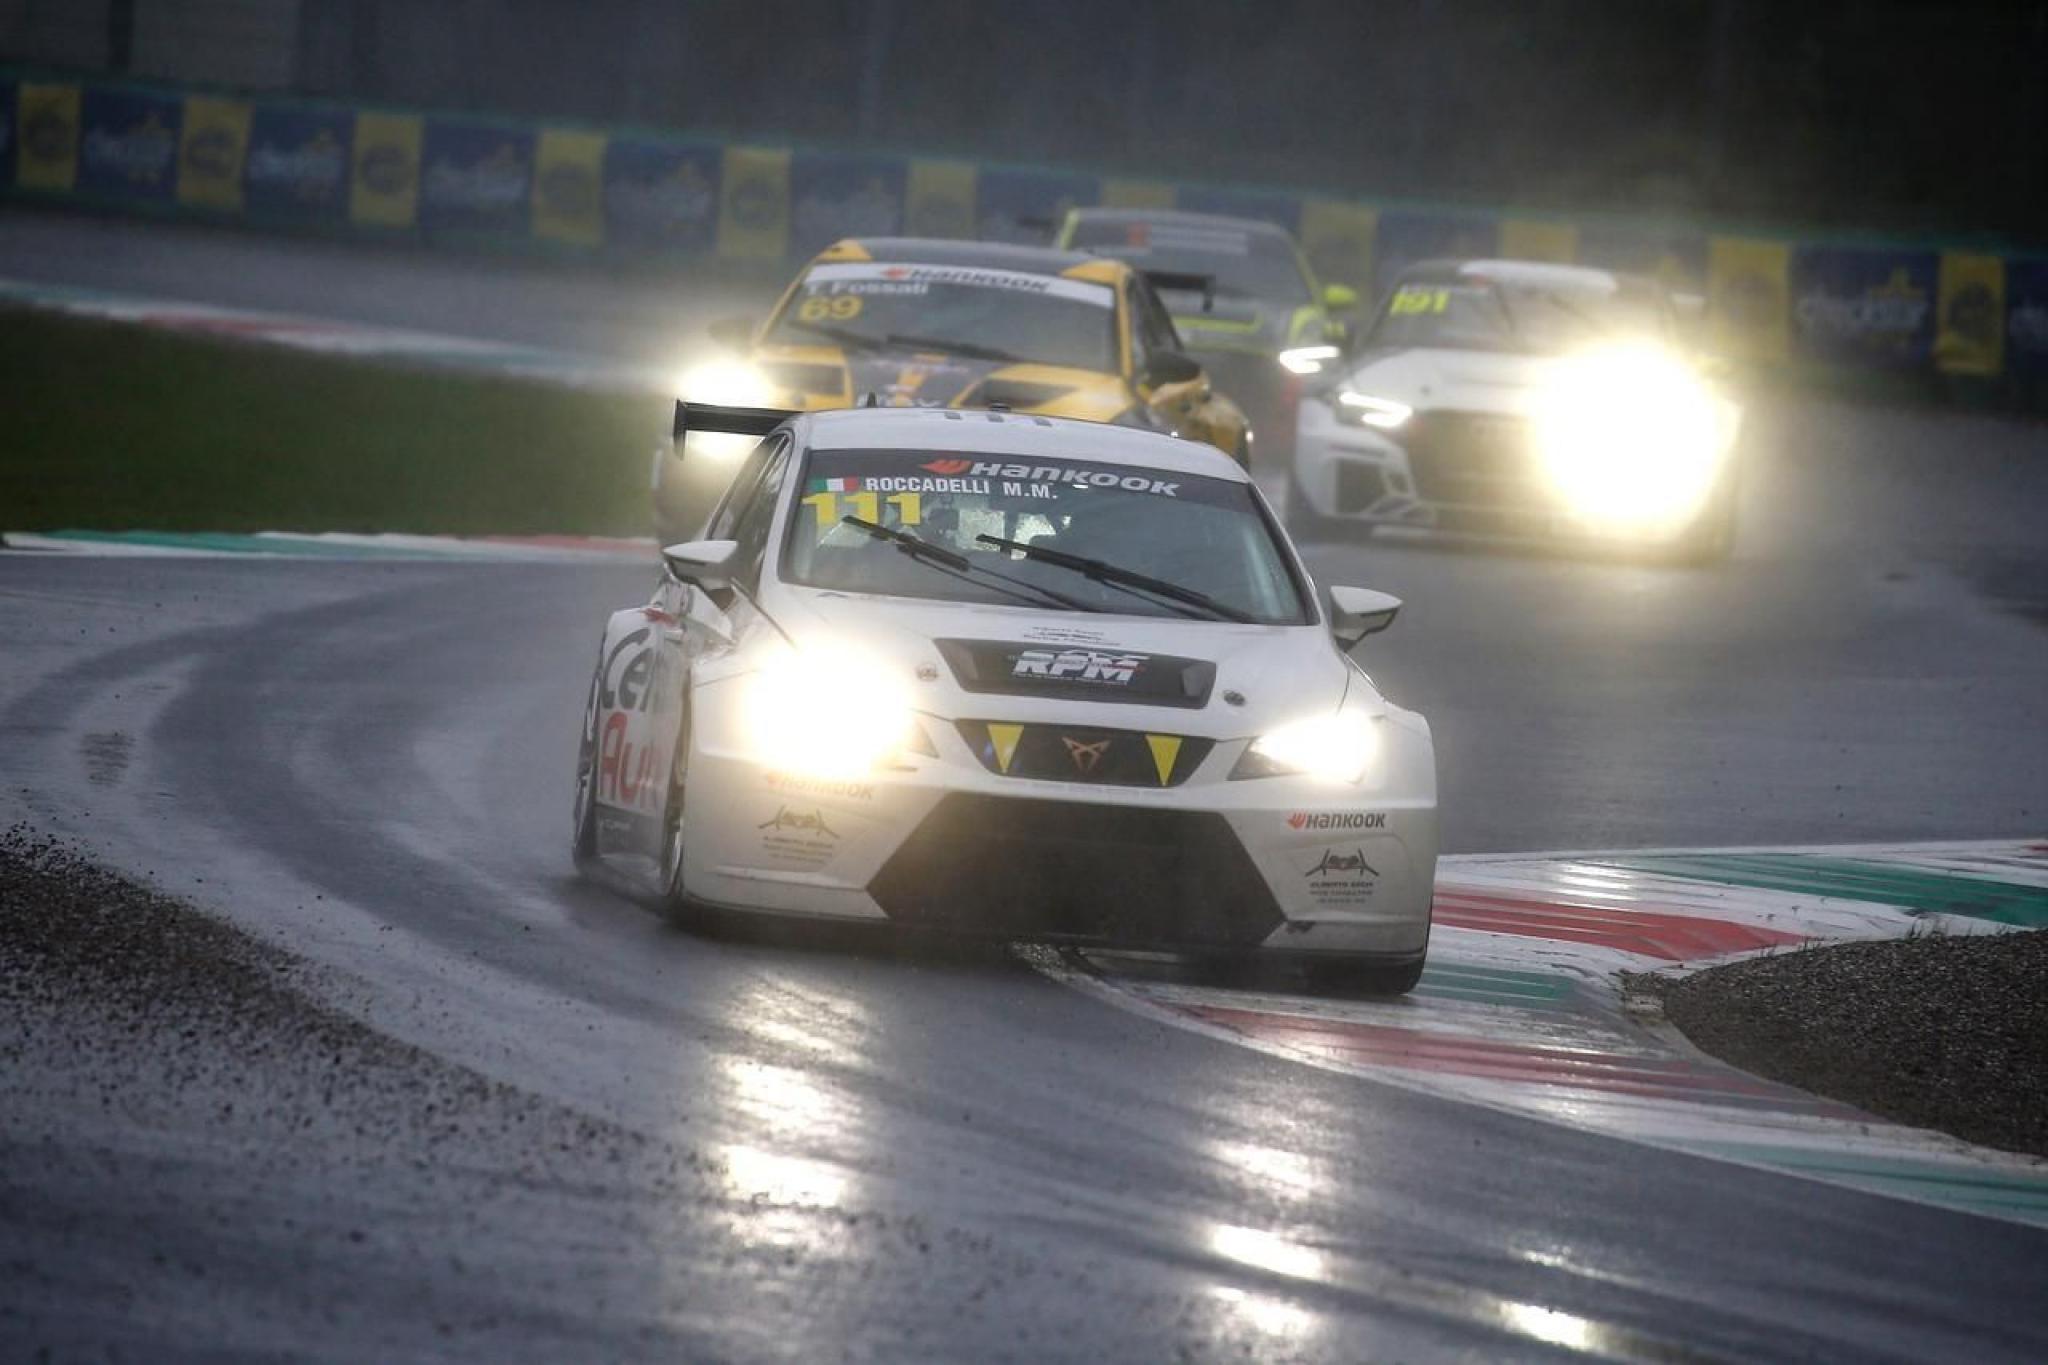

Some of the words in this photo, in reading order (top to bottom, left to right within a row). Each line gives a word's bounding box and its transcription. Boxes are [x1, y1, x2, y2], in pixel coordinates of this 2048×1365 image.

[832, 280, 929, 296] Fossati
[800, 296, 864, 322] 69
[866, 476, 990, 494] ROCCADELLI
[1003, 481, 1058, 499] M.M.
[802, 491, 922, 527] 111
[1012, 650, 1148, 683] RPM
